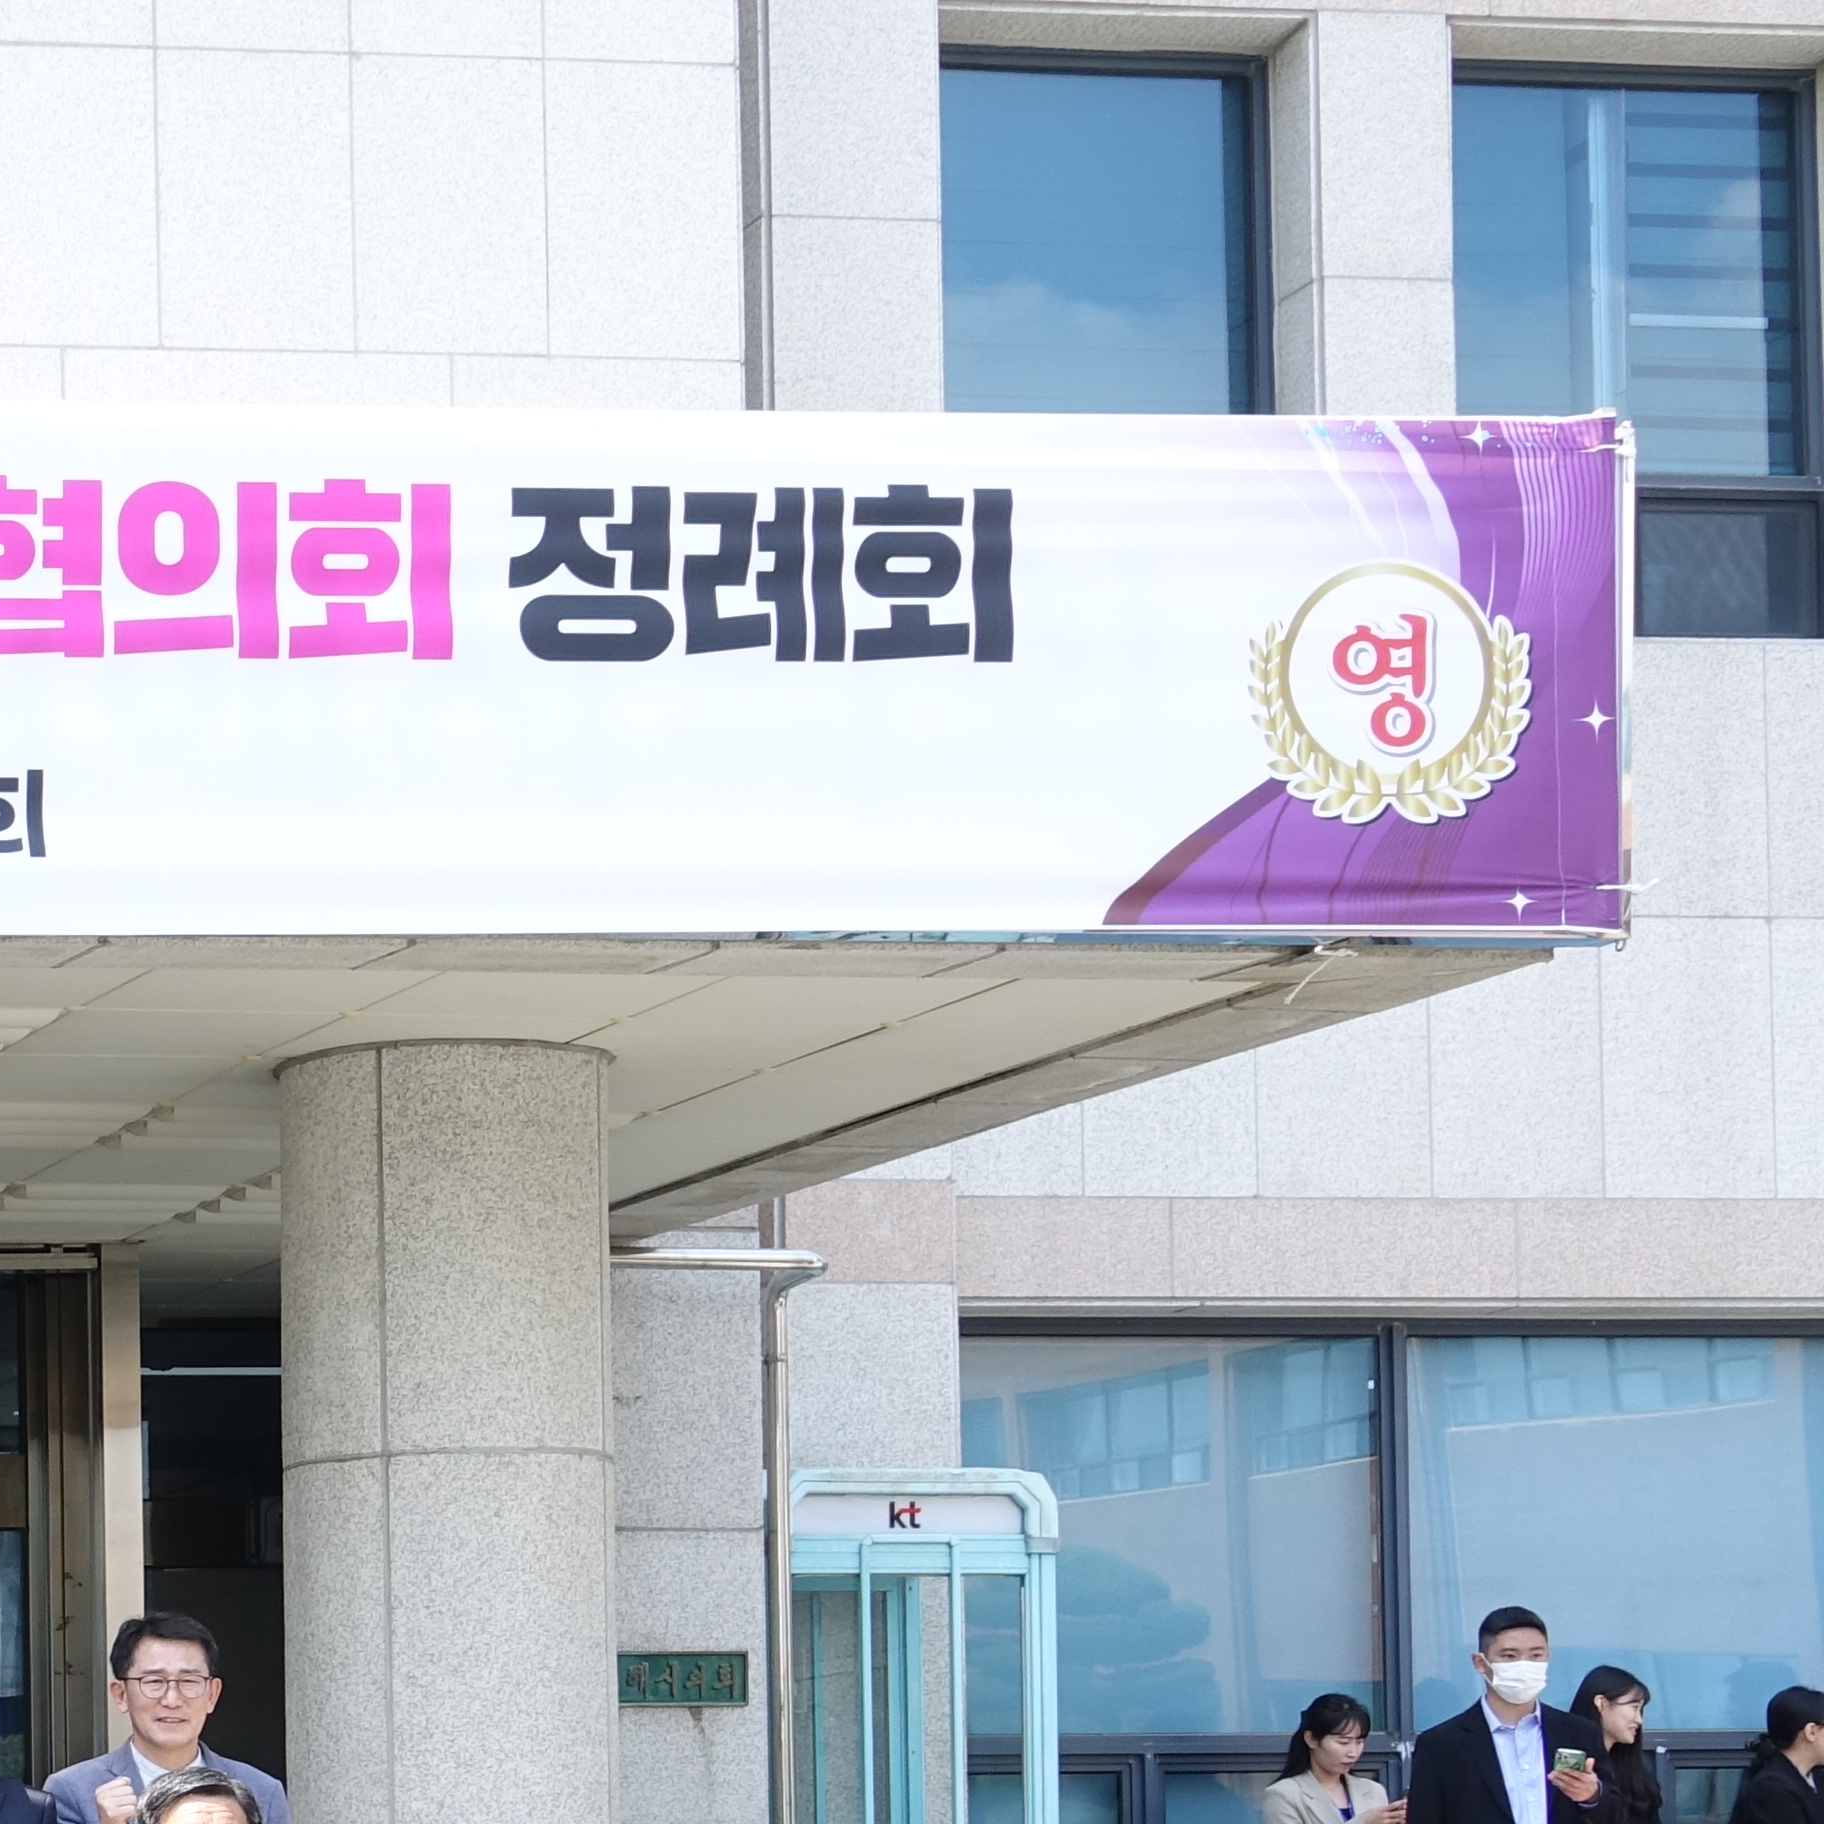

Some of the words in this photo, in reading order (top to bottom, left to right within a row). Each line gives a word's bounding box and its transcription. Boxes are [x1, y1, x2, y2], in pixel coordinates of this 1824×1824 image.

[509, 485, 1015, 664] 정례회
[1332, 613, 1428, 748] 영
[889, 1501, 921, 1528] kt
